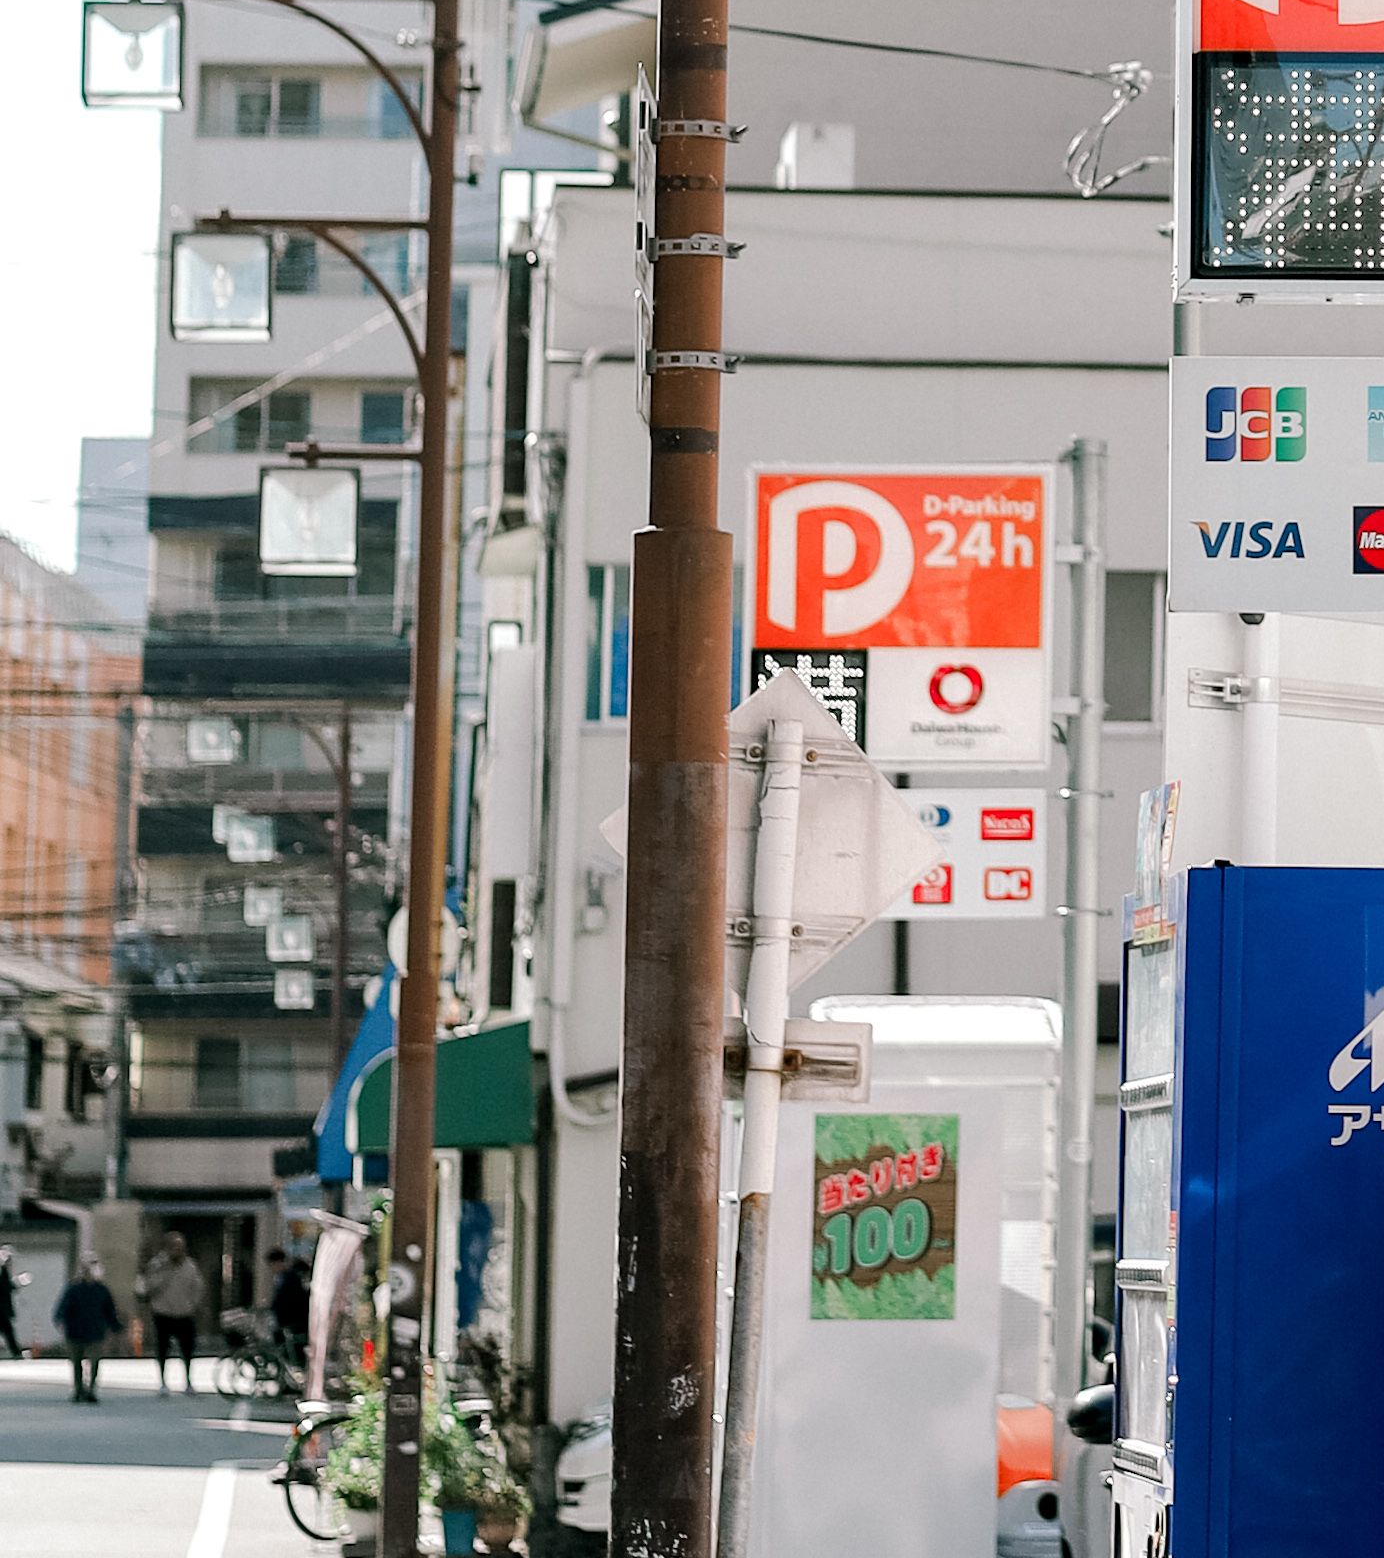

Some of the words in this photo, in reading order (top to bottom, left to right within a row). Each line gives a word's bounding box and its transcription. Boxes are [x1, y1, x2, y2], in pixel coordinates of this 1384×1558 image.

[924, 494, 1037, 519] D-Parking
[924, 521, 1034, 568] 24h
[1190, 520, 1305, 560] VISA
[819, 1142, 944, 1215] 当たり付き
[823, 1198, 930, 1275] 100
